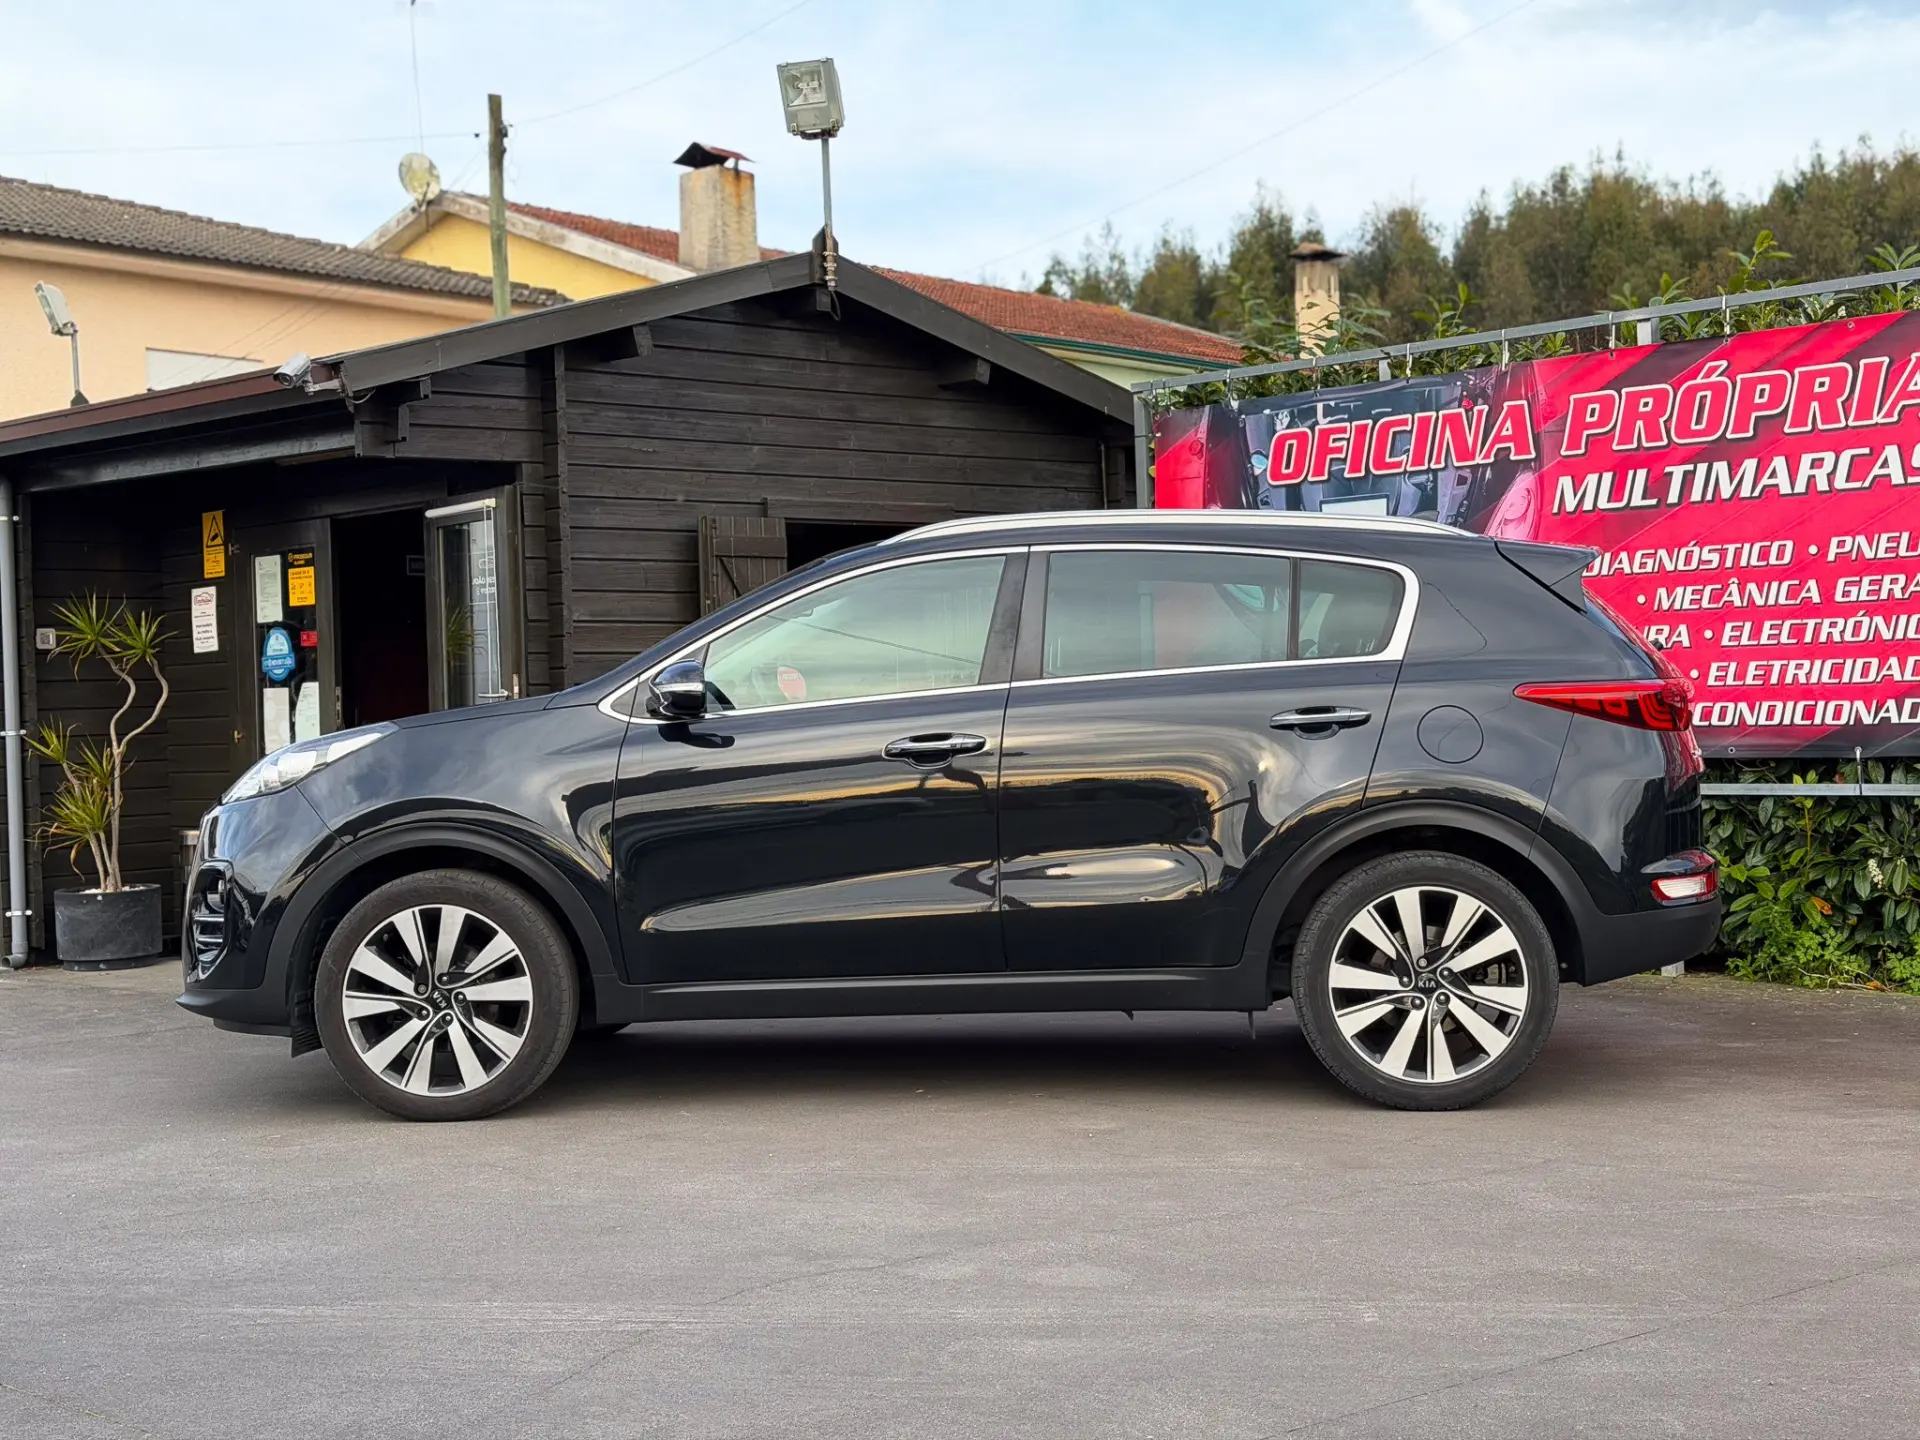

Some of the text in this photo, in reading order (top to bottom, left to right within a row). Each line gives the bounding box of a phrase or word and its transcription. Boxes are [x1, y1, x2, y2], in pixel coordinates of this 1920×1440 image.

[1267, 351, 1920, 486] OFICINA PRÓPRIA
[1653, 577, 1822, 611] MECÂNICA
[1418, 979, 1437, 988] KIA
[433, 991, 447, 1008] KIA
